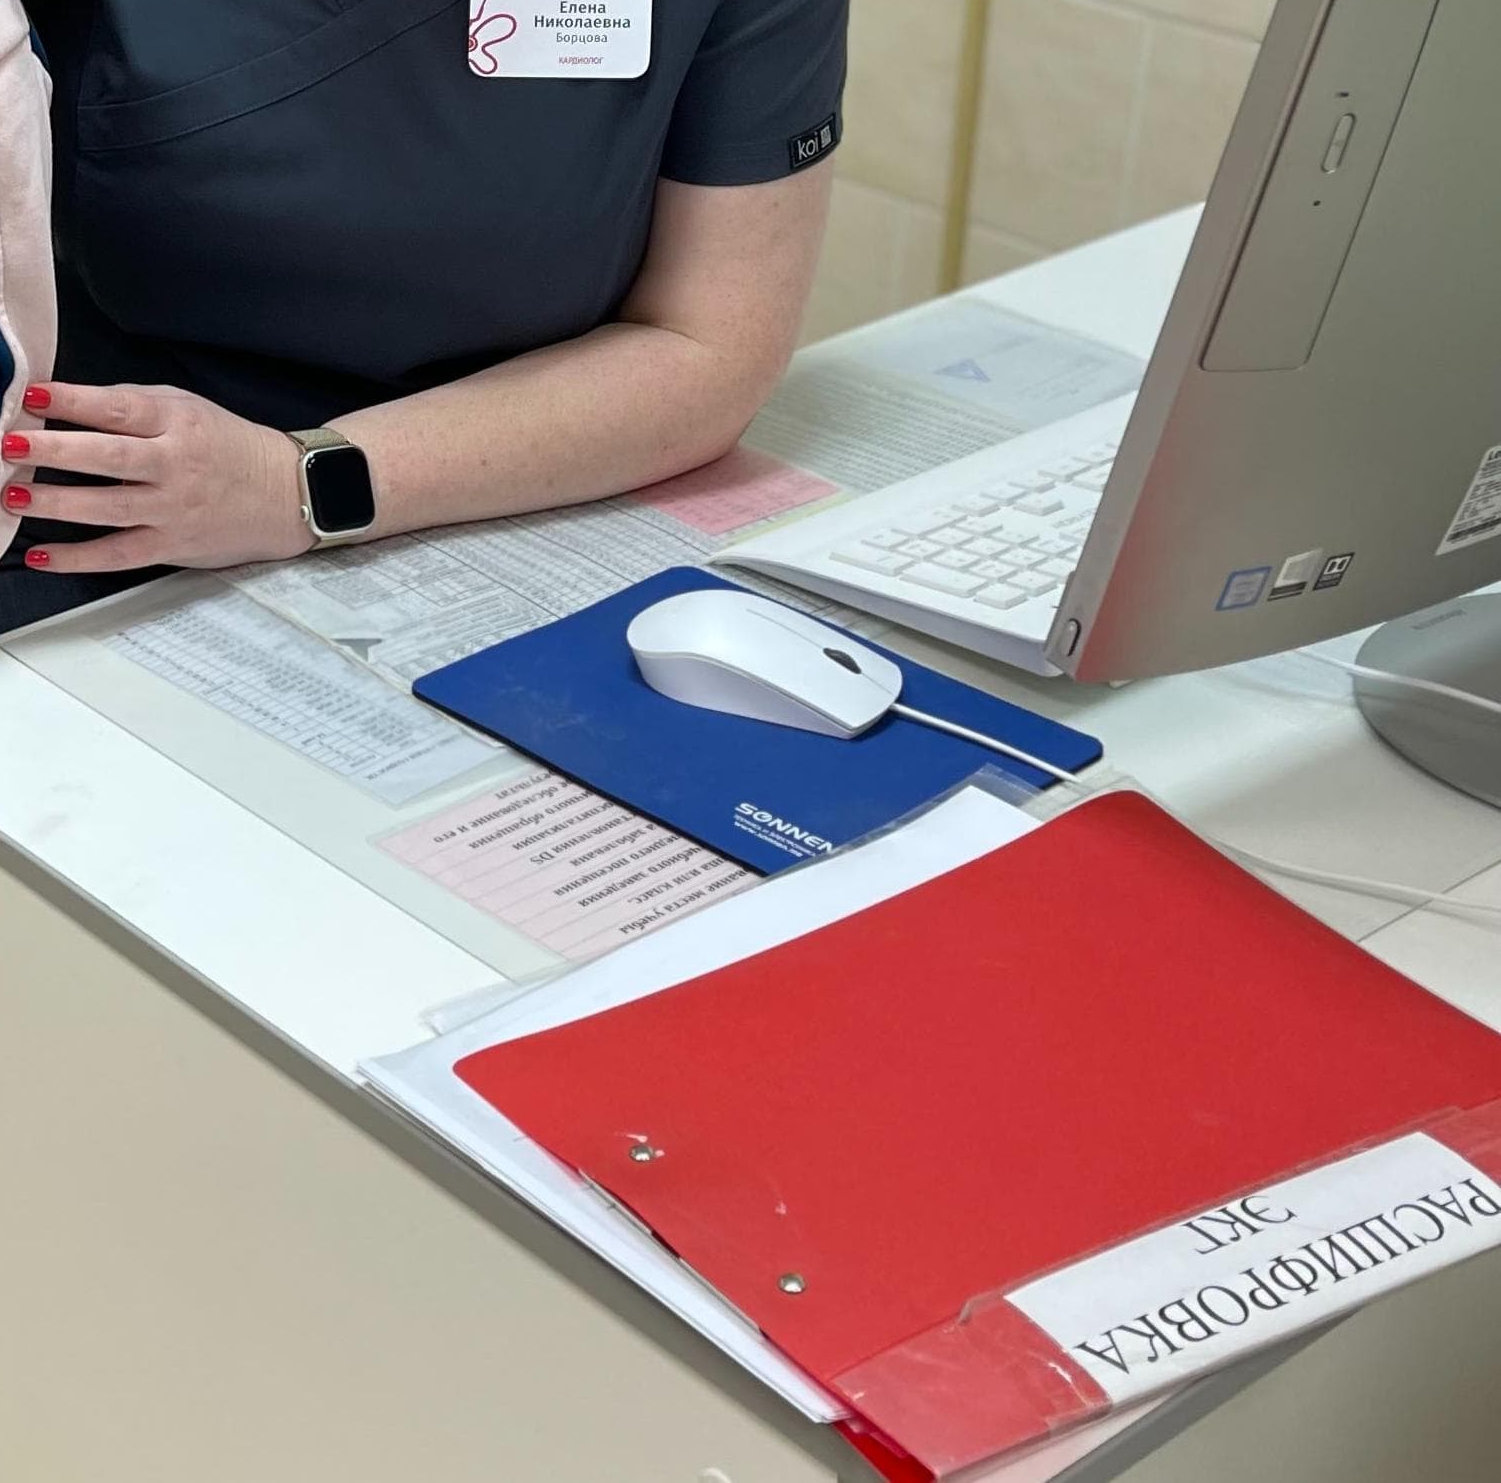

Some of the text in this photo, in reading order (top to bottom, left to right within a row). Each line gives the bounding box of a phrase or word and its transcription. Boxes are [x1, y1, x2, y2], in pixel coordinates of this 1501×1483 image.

[560, 1, 607, 14] Елена
[534, 15, 631, 28] Николаевна
[556, 32, 608, 45] Борцова
[558, 55, 604, 65] КАРДИОЛОГ
[797, 131, 819, 160] koi
[470, 785, 559, 828] обследование
[433, 829, 457, 844] его
[456, 822, 470, 834] и
[468, 811, 545, 849] обращения
[529, 851, 555, 865] DS
[553, 858, 630, 897] посещения
[672, 867, 702, 886] или
[578, 871, 648, 908] заведения
[617, 868, 750, 935] вание места учебы
[1180, 1195, 1297, 1255] ЭКГ
[1073, 1177, 1501, 1375] РАСШИФРОВКА
